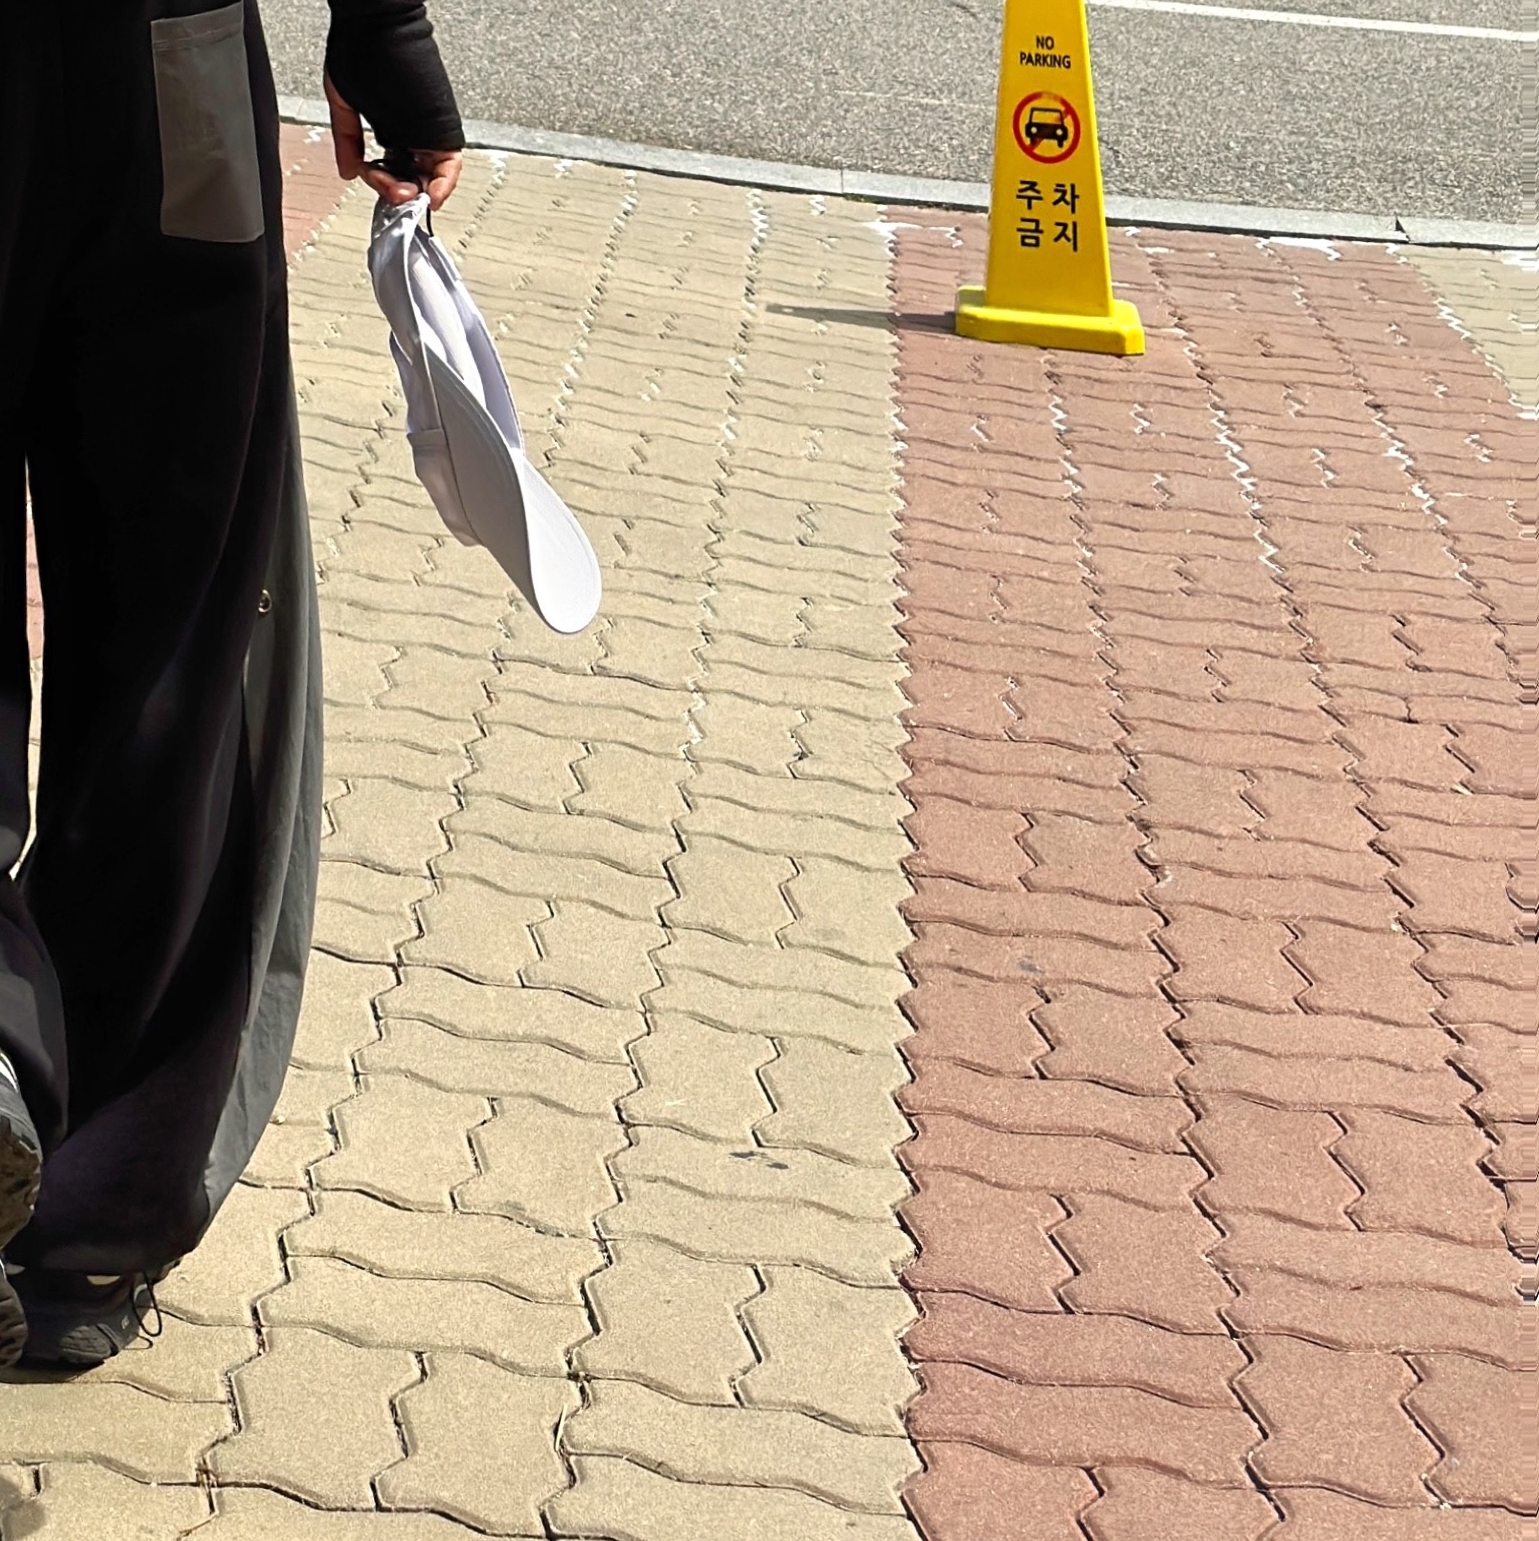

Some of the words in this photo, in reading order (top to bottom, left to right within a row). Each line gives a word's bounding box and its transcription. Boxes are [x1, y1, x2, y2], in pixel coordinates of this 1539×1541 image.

[1035, 35, 1055, 51] NO
[1019, 51, 1072, 70] PARKING
[1015, 179, 1080, 215] 주차
[1016, 217, 1079, 253] 금지
